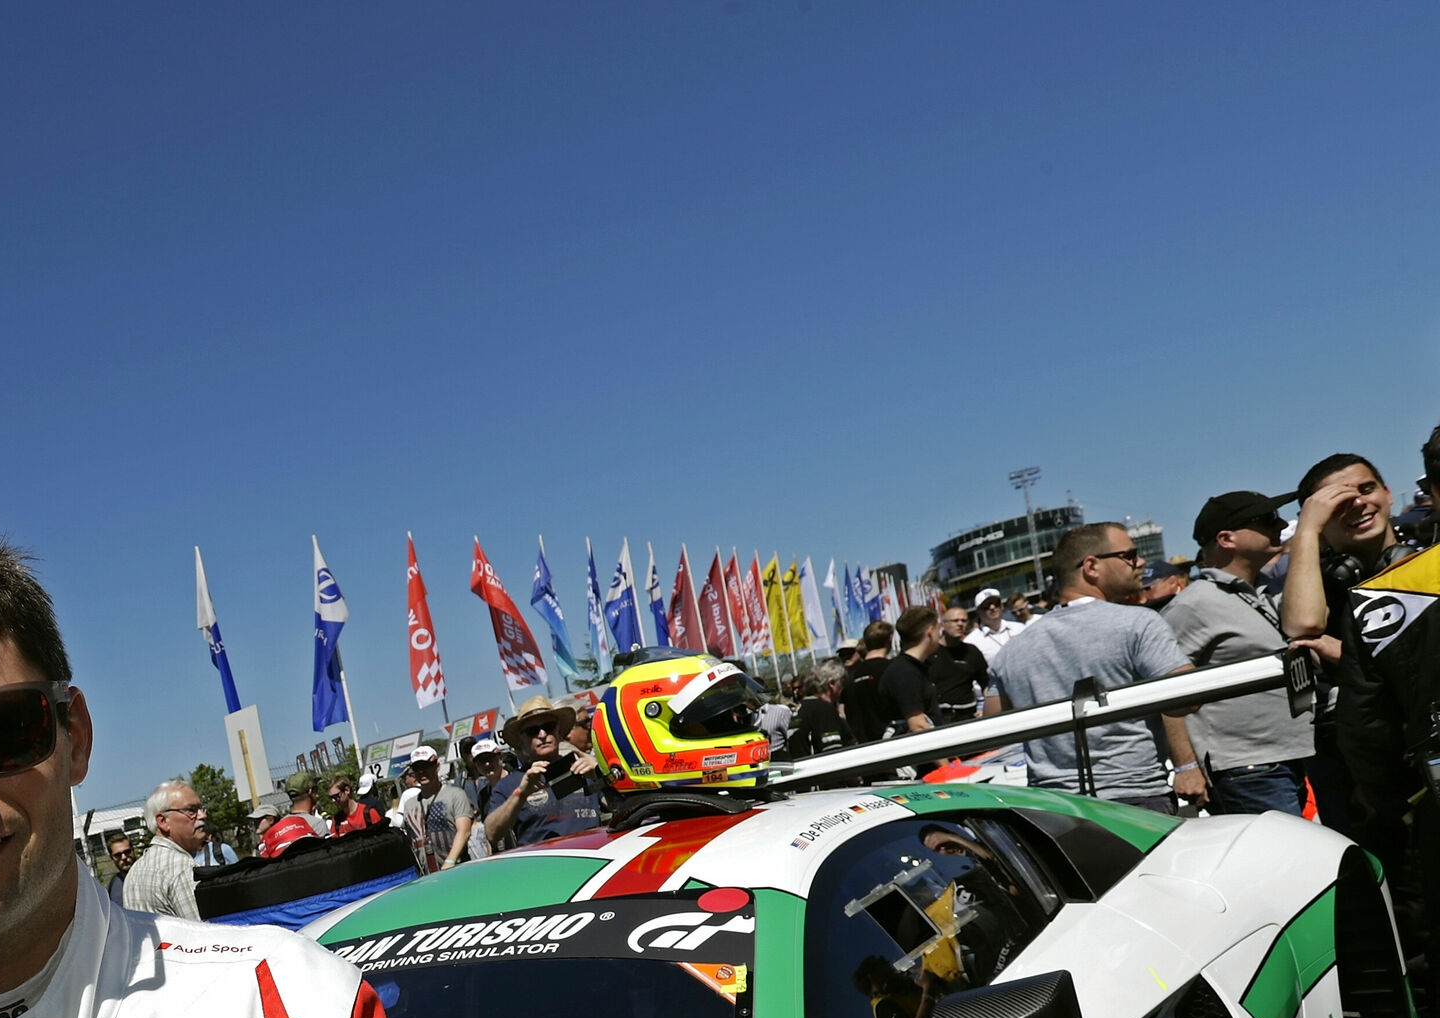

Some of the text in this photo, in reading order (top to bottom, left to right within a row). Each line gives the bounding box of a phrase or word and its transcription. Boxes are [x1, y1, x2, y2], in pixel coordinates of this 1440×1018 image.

[800, 827, 820, 842] De
[173, 944, 253, 954] Audi Sport
[333, 911, 595, 965] RAN TURISMO
[361, 942, 559, 972] DRIVING SIMULATOR
